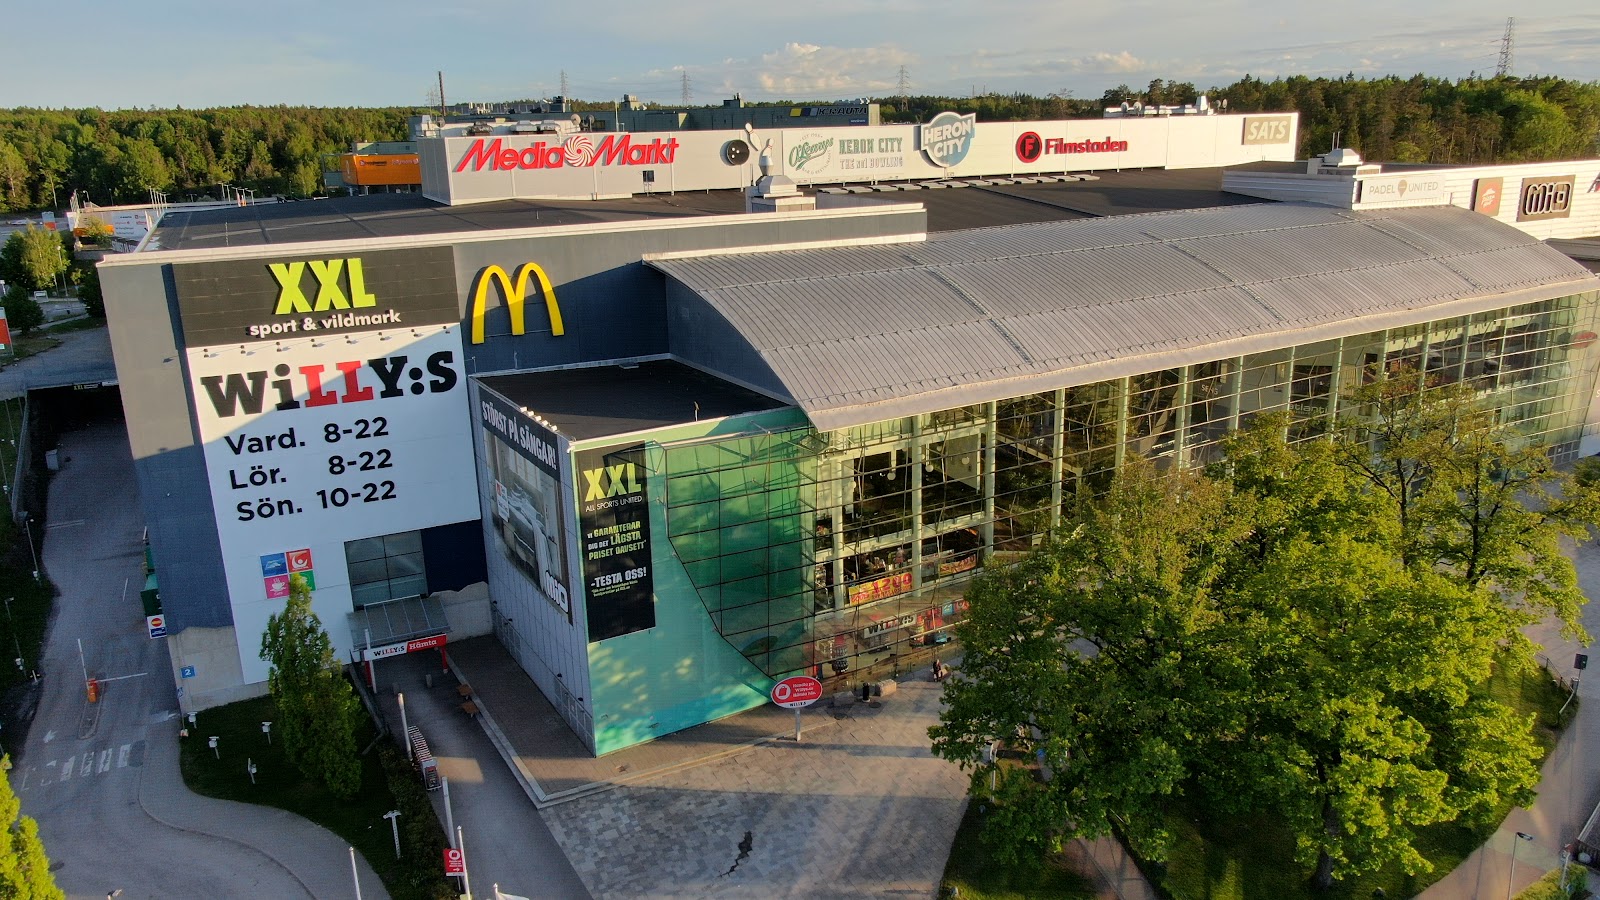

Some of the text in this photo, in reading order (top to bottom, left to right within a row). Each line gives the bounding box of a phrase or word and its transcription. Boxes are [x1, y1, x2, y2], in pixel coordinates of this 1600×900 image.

[925, 119, 971, 144] HERON
[1247, 120, 1288, 140] SATS
[456, 134, 679, 172] Media Markt
[839, 136, 902, 154] HERON CITY
[934, 137, 966, 157] CITY
[1044, 136, 1128, 155] Filmstaden
[840, 158, 854, 169] THE
[870, 156, 903, 169] BOWLING
[1369, 181, 1438, 195] PADEL UNITED
[267, 258, 377, 315] XXL
[249, 309, 401, 339] sport & vildmark
[224, 416, 389, 456] Vard. 8-22
[482, 400, 558, 471] STÖRST PÅ SÄNGAR!
[229, 448, 393, 490] Lör. 8-22
[583, 462, 642, 502] XXL
[237, 480, 397, 522] Sön. 10-22
[585, 495, 643, 513] ALL SPORTS UNITED
[593, 520, 641, 537] GARANTERAR
[598, 540, 609, 548] DET
[610, 530, 641, 546] LÄGSTA
[588, 547, 614, 561] PRISET
[624, 566, 647, 581] OSS!
[409, 638, 438, 651] Hämta
[184, 668, 192, 676] 2
